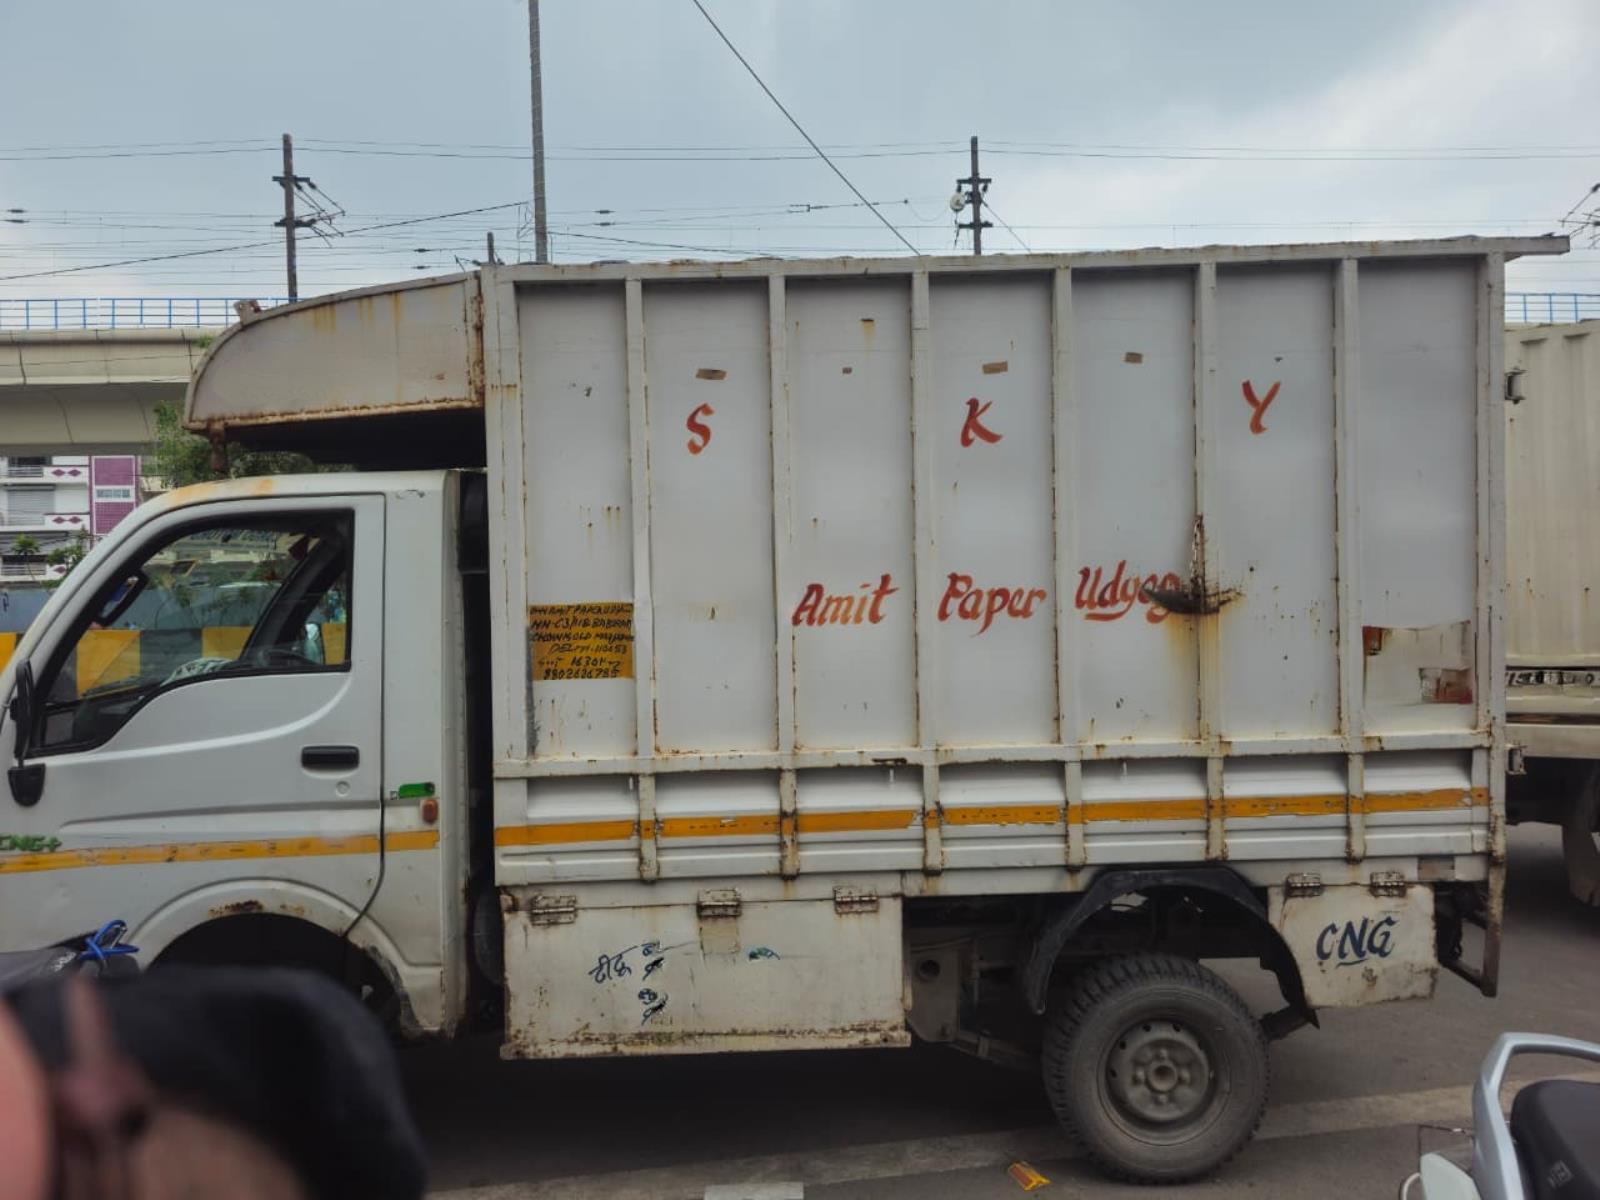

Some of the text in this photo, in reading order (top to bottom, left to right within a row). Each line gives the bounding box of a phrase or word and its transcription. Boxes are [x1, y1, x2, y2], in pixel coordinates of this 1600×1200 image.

[686, 380, 1282, 455] S K Y
[791, 573, 898, 627] Amit
[1316, 916, 1398, 964] CNG
